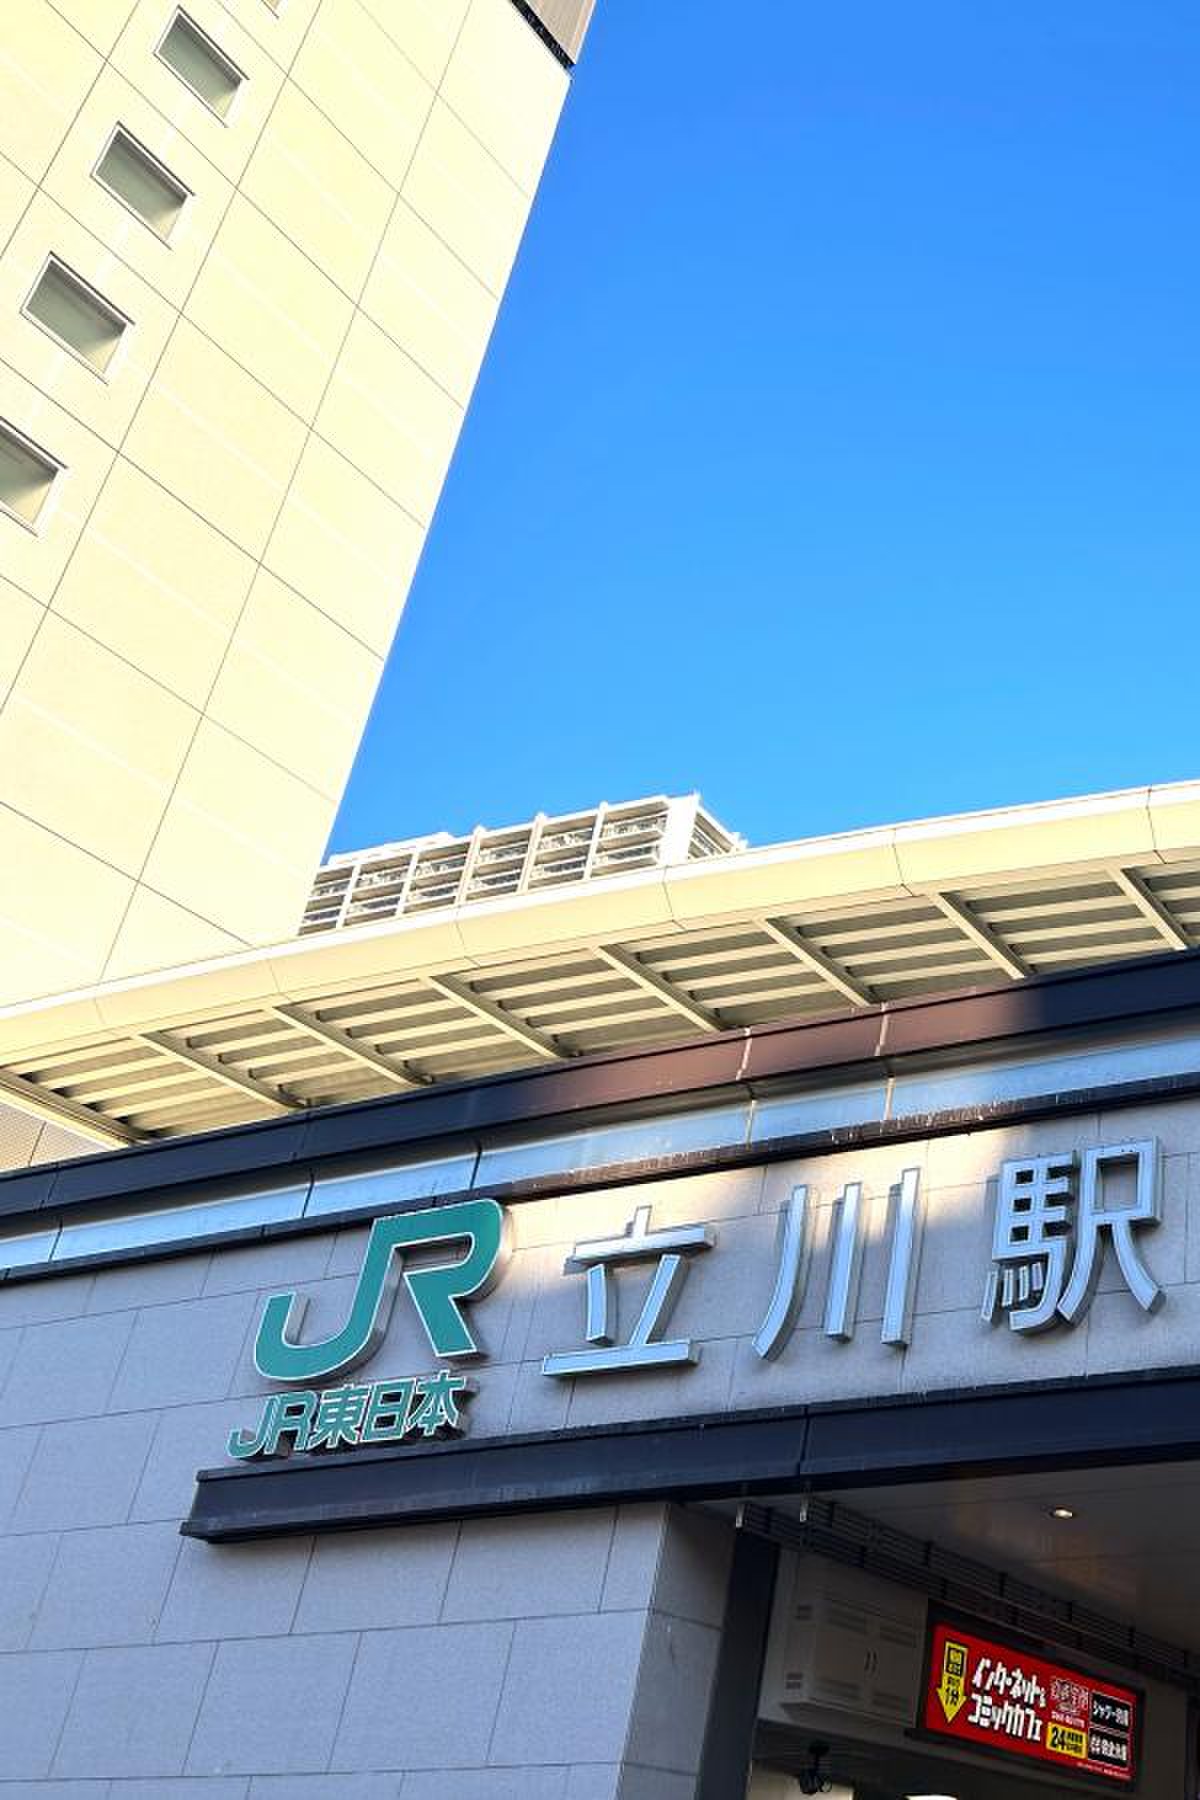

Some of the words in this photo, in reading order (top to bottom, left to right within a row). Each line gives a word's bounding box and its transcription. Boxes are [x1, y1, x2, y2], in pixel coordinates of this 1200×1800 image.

[255, 1198, 504, 1381] JR
[227, 1369, 466, 1457] JR東日本
